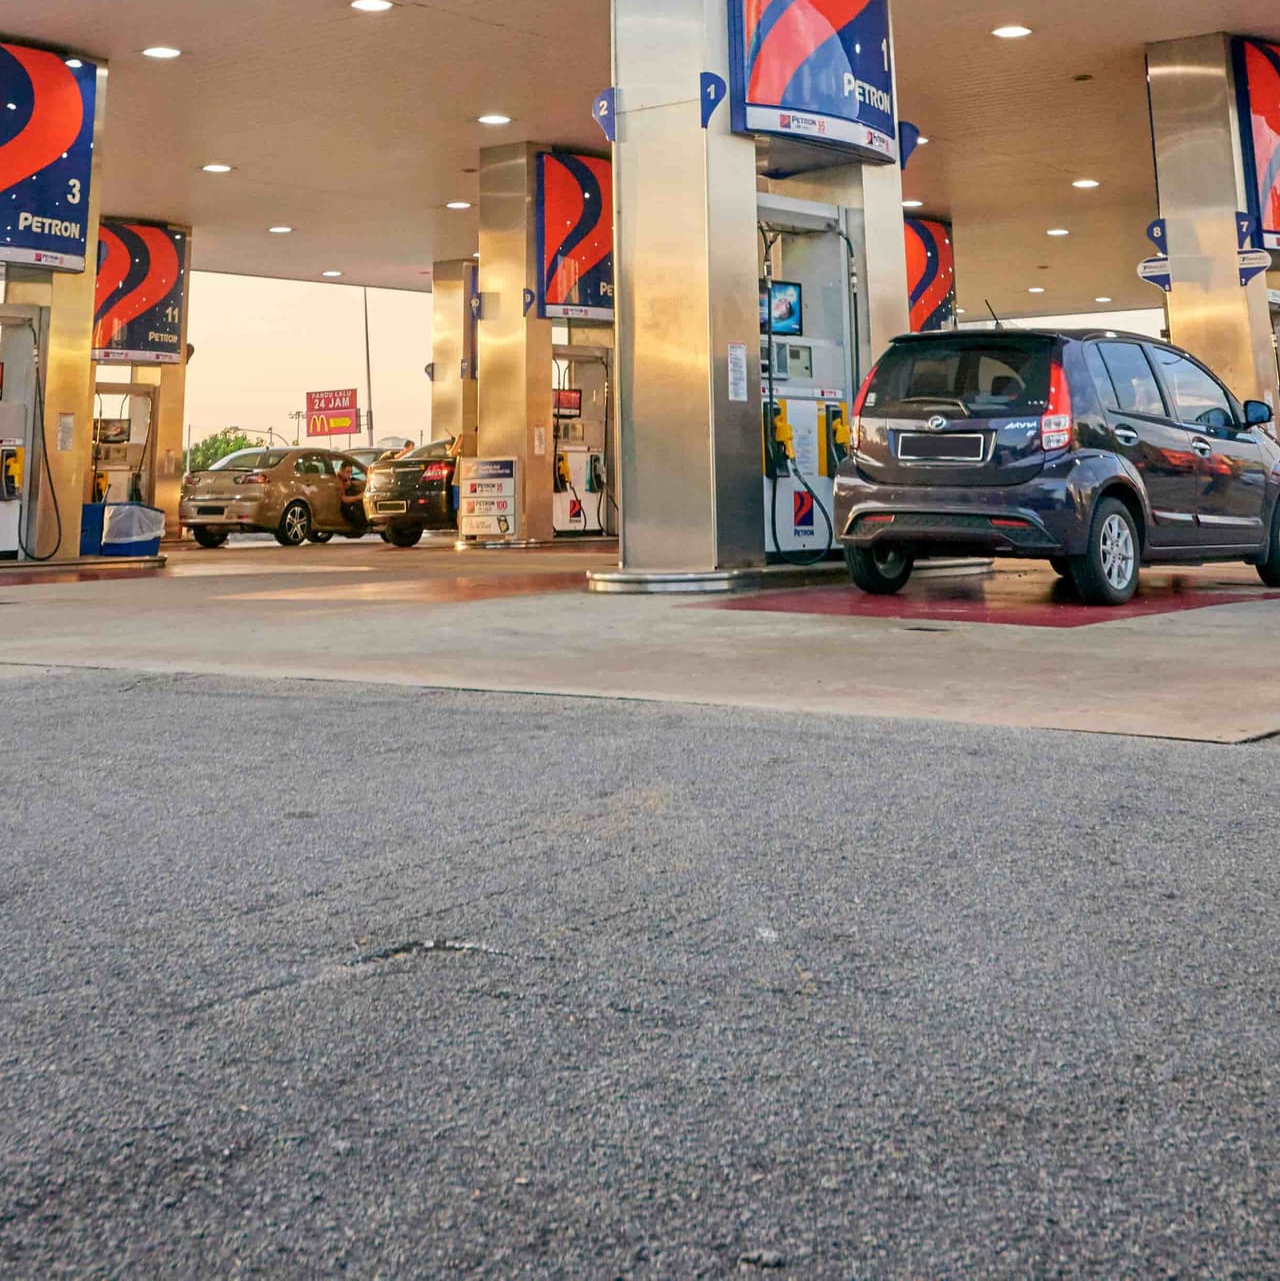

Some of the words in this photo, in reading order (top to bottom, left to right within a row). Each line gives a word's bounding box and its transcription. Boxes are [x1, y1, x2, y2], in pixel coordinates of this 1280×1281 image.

[881, 37, 889, 72] 1
[707, 84, 716, 100] 1
[843, 72, 892, 115] PETRON
[599, 100, 609, 115] 2
[791, 115, 817, 126] PETRON
[66, 178, 81, 205] 3
[18, 211, 81, 239] PETRON
[1152, 226, 1162, 237] 8
[1240, 221, 1250, 232] 7
[166, 306, 179, 324] 11
[148, 331, 178, 343] PETRON
[314, 399, 326, 410] 24
[328, 397, 350, 409] JAM
[496, 500, 508, 510] 100
